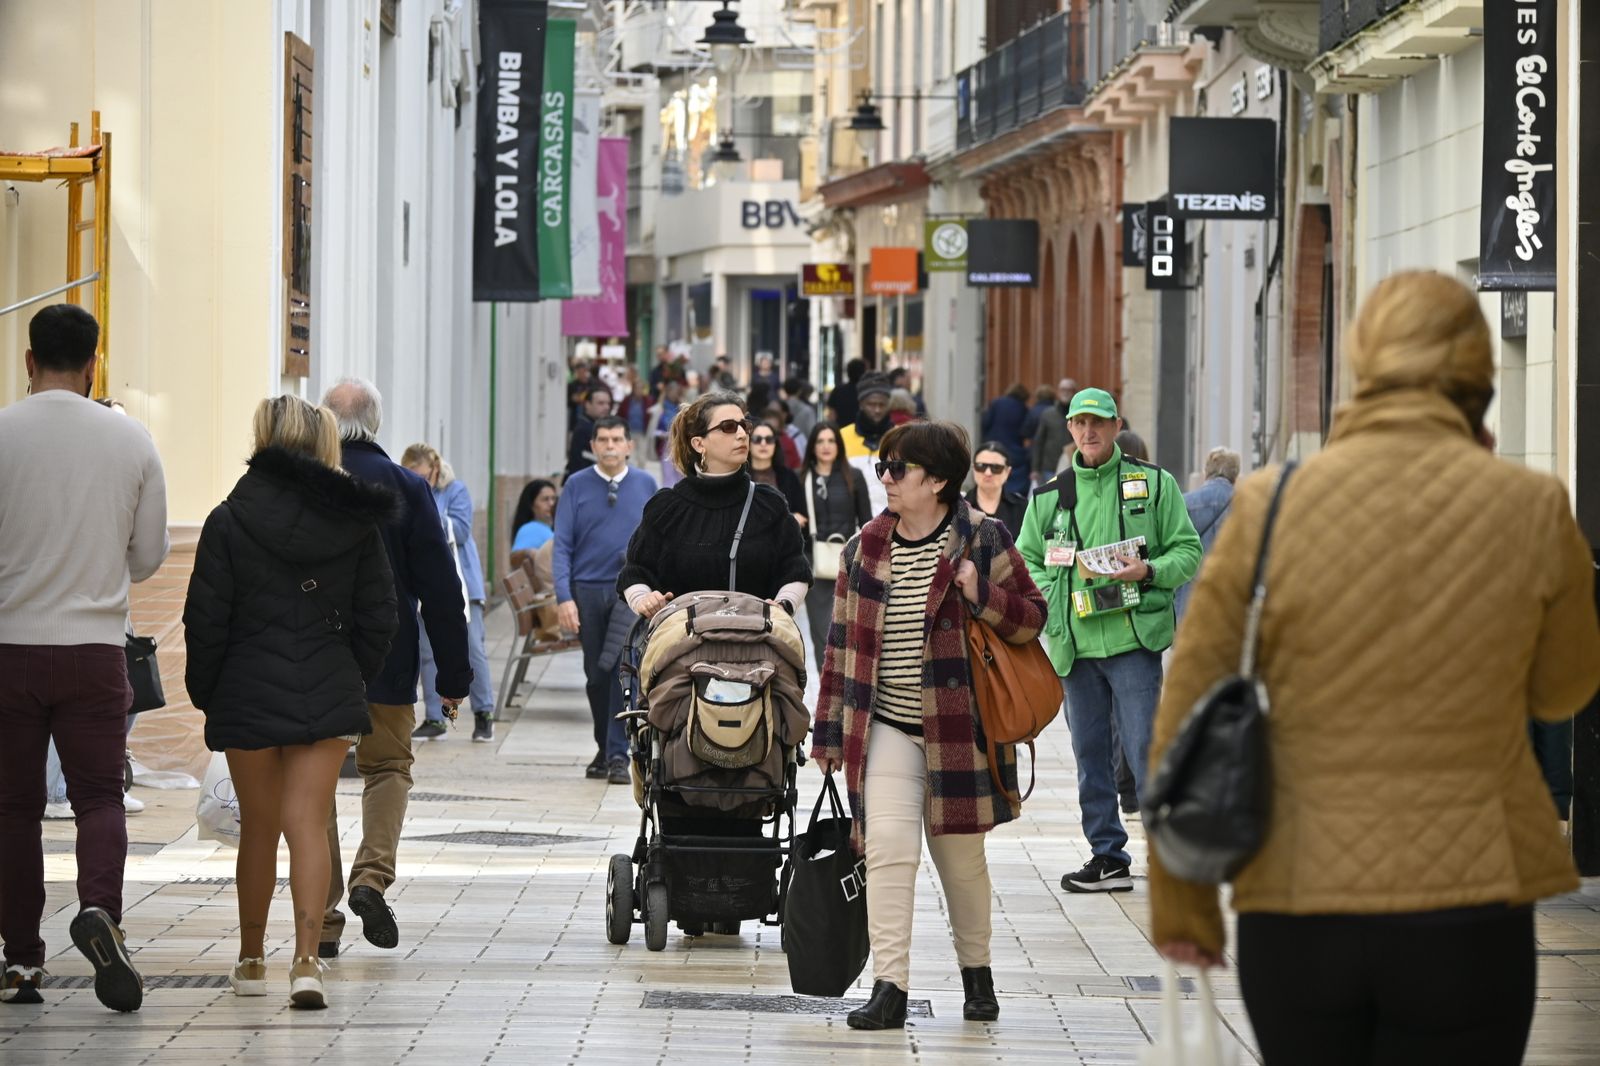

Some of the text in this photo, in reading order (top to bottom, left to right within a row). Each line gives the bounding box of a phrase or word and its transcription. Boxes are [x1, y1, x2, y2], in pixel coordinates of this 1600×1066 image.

[1516, 0, 1537, 45] ES
[1515, 54, 1548, 86] El
[494, 51, 522, 247] BIMBA Y LOLA
[1515, 86, 1546, 157] Corte
[543, 90, 565, 228] CARCASAS
